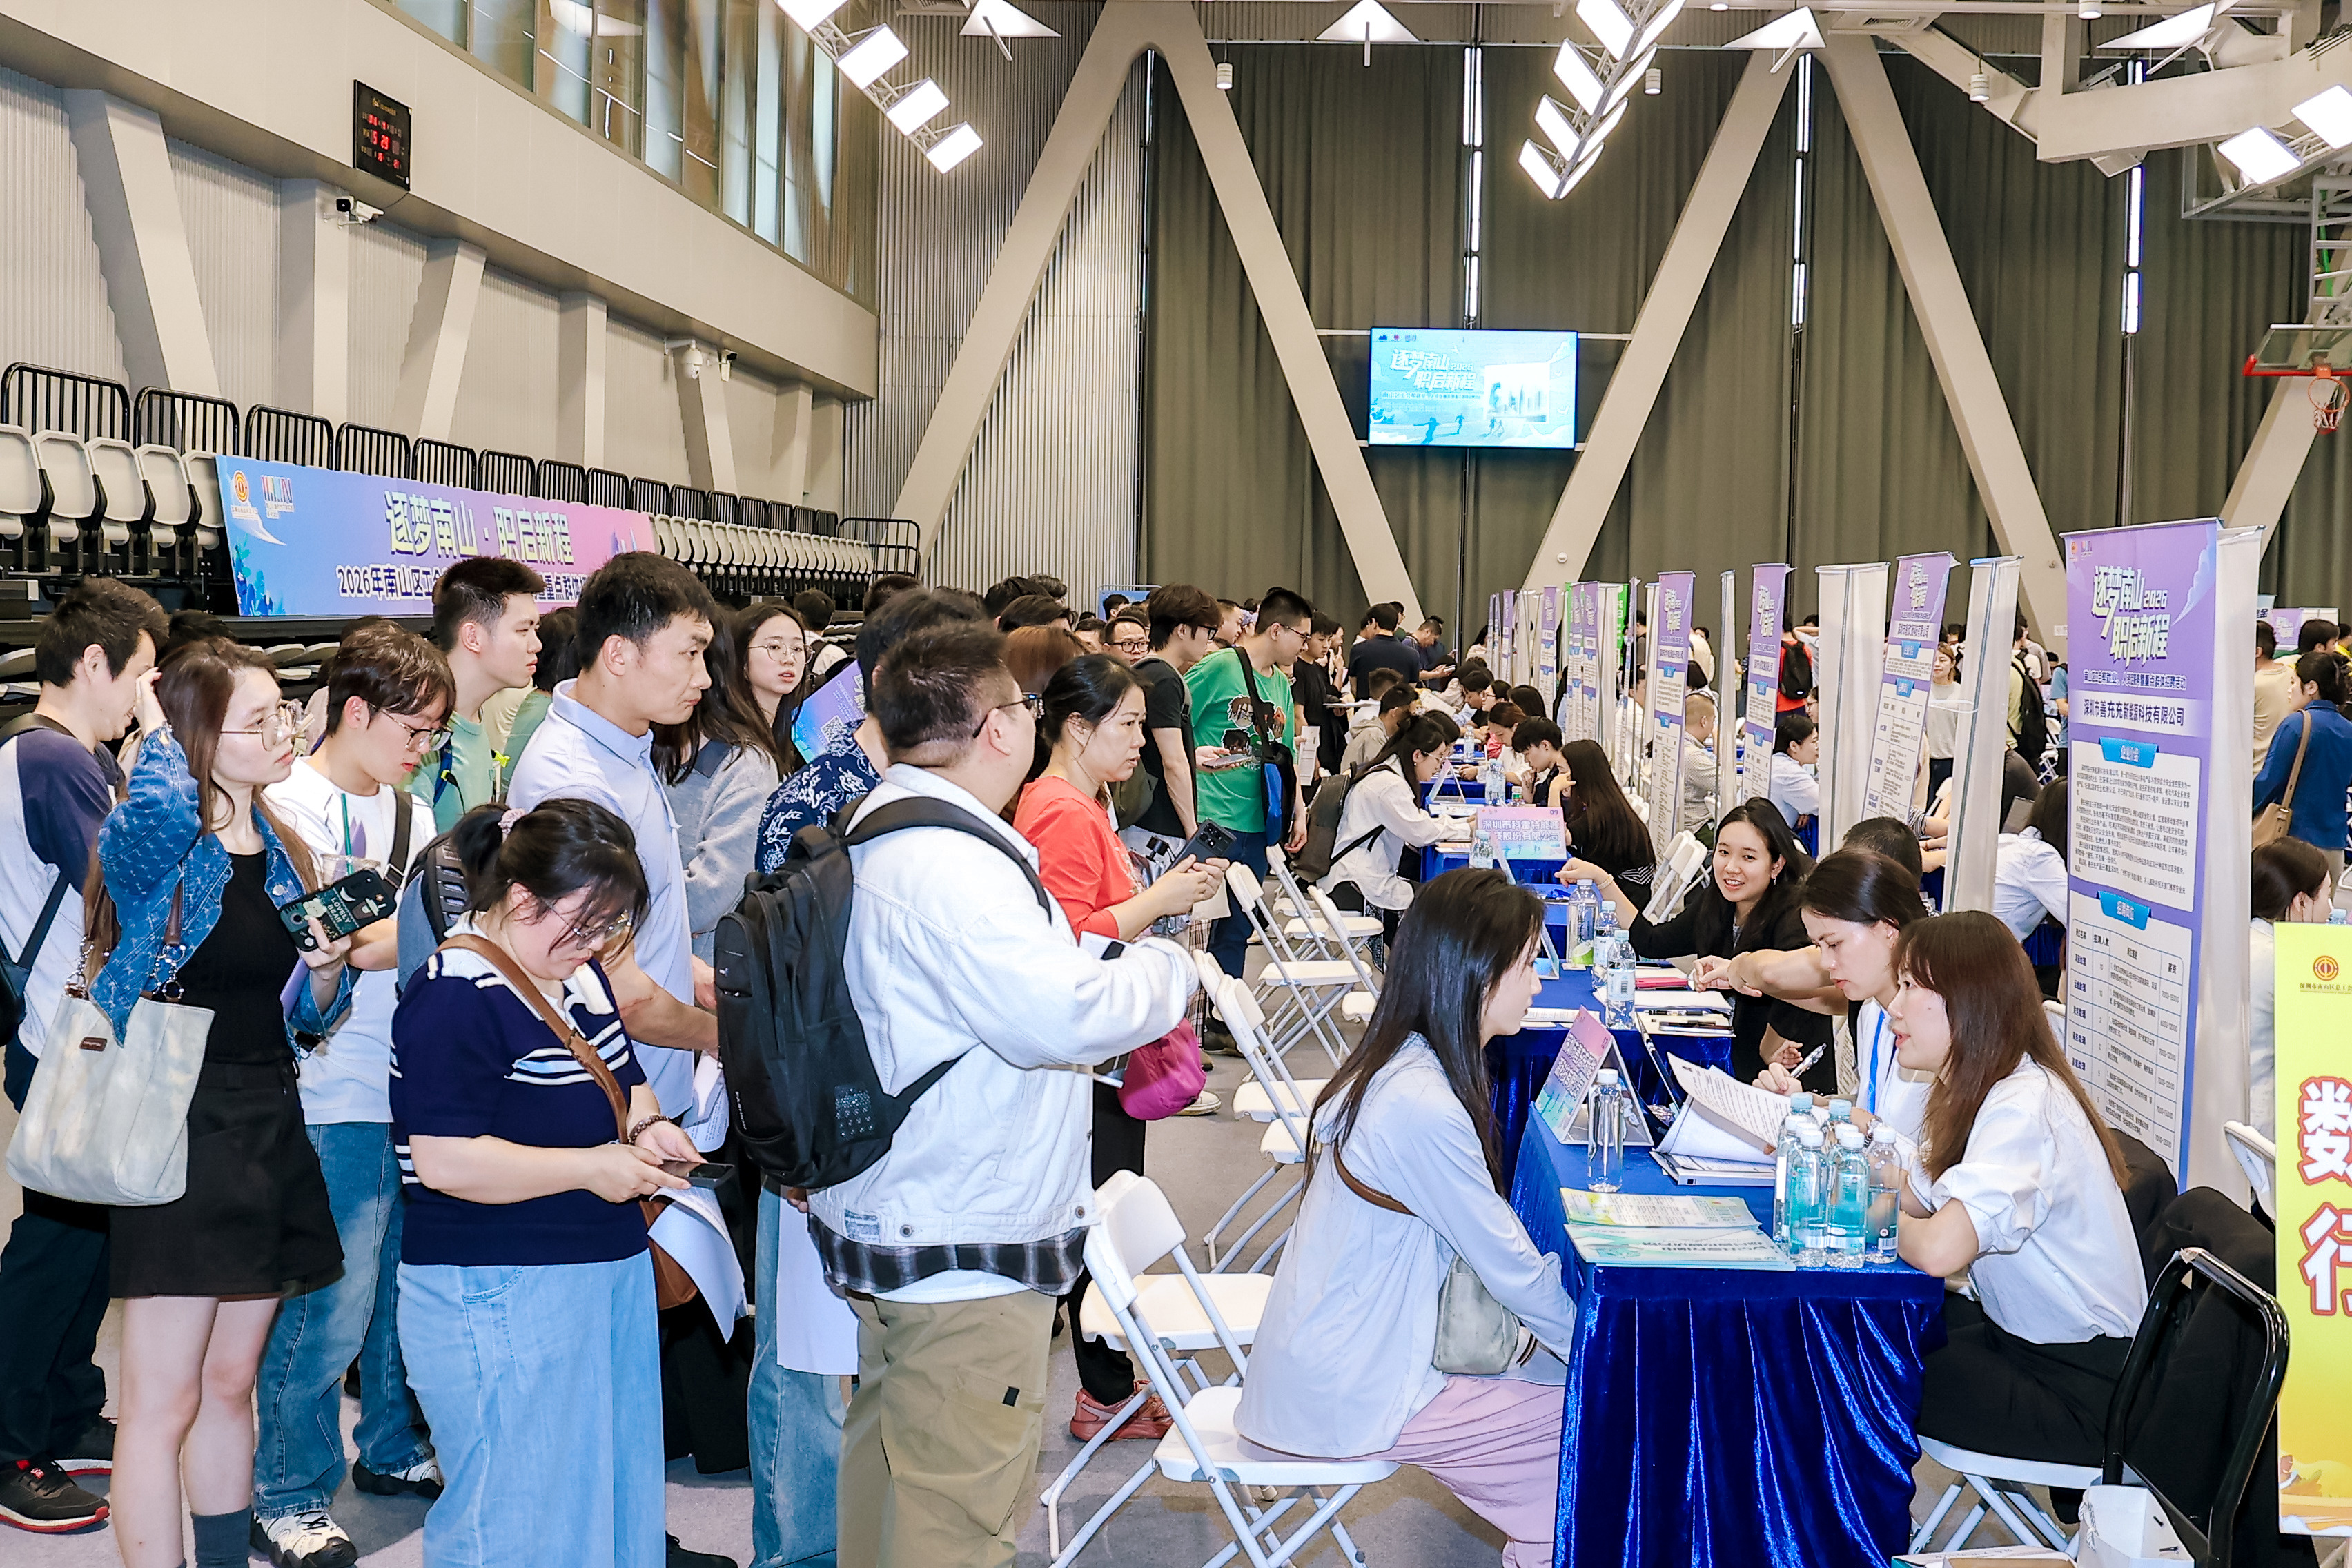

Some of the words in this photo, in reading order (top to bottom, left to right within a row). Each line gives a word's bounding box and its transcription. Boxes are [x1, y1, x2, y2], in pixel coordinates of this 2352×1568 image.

[1390, 348, 1450, 379] 逐梦南山
[1450, 362, 1474, 371] 2026
[1413, 371, 1477, 392] 职启新程
[385, 490, 575, 565] 逐梦南山·职启新程
[2090, 565, 2145, 639] 逐梦南山
[2142, 589, 2168, 611] 2026
[2109, 613, 2172, 669] 职启新程
[2083, 698, 2185, 727] 深圳市善充充新能源科技有限公司
[1487, 831, 1561, 841] 技股份有限公司
[327, 904, 342, 923] BEAR
[331, 896, 351, 923] LOVELY
